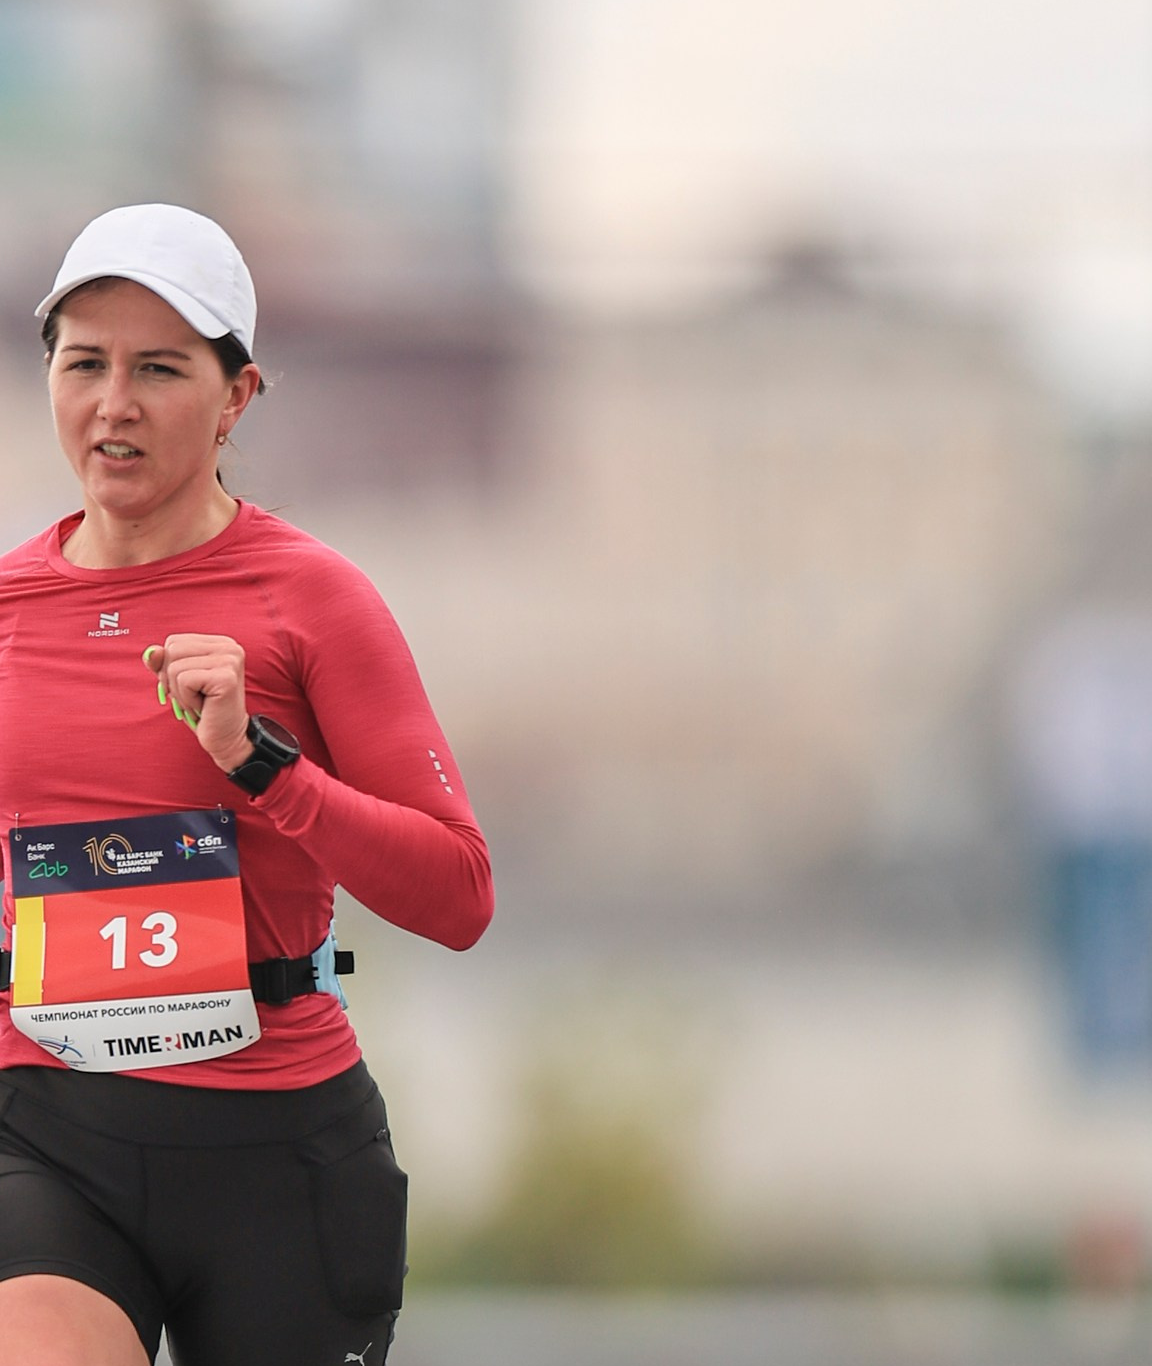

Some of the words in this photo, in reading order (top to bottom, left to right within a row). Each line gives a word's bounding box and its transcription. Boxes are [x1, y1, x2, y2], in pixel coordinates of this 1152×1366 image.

[88, 629, 130, 637] NORDSKI
[27, 852, 46, 861] Банк
[116, 857, 159, 868] КАЗАНСКИЙ
[117, 865, 152, 875] МАРАФОН
[99, 912, 179, 970] 13
[31, 1009, 99, 1023] ЧЕМПИОНАТ
[101, 1005, 146, 1017] РОССИИ
[148, 1004, 165, 1014] ПО
[168, 998, 232, 1012] МАРАФОНУ
